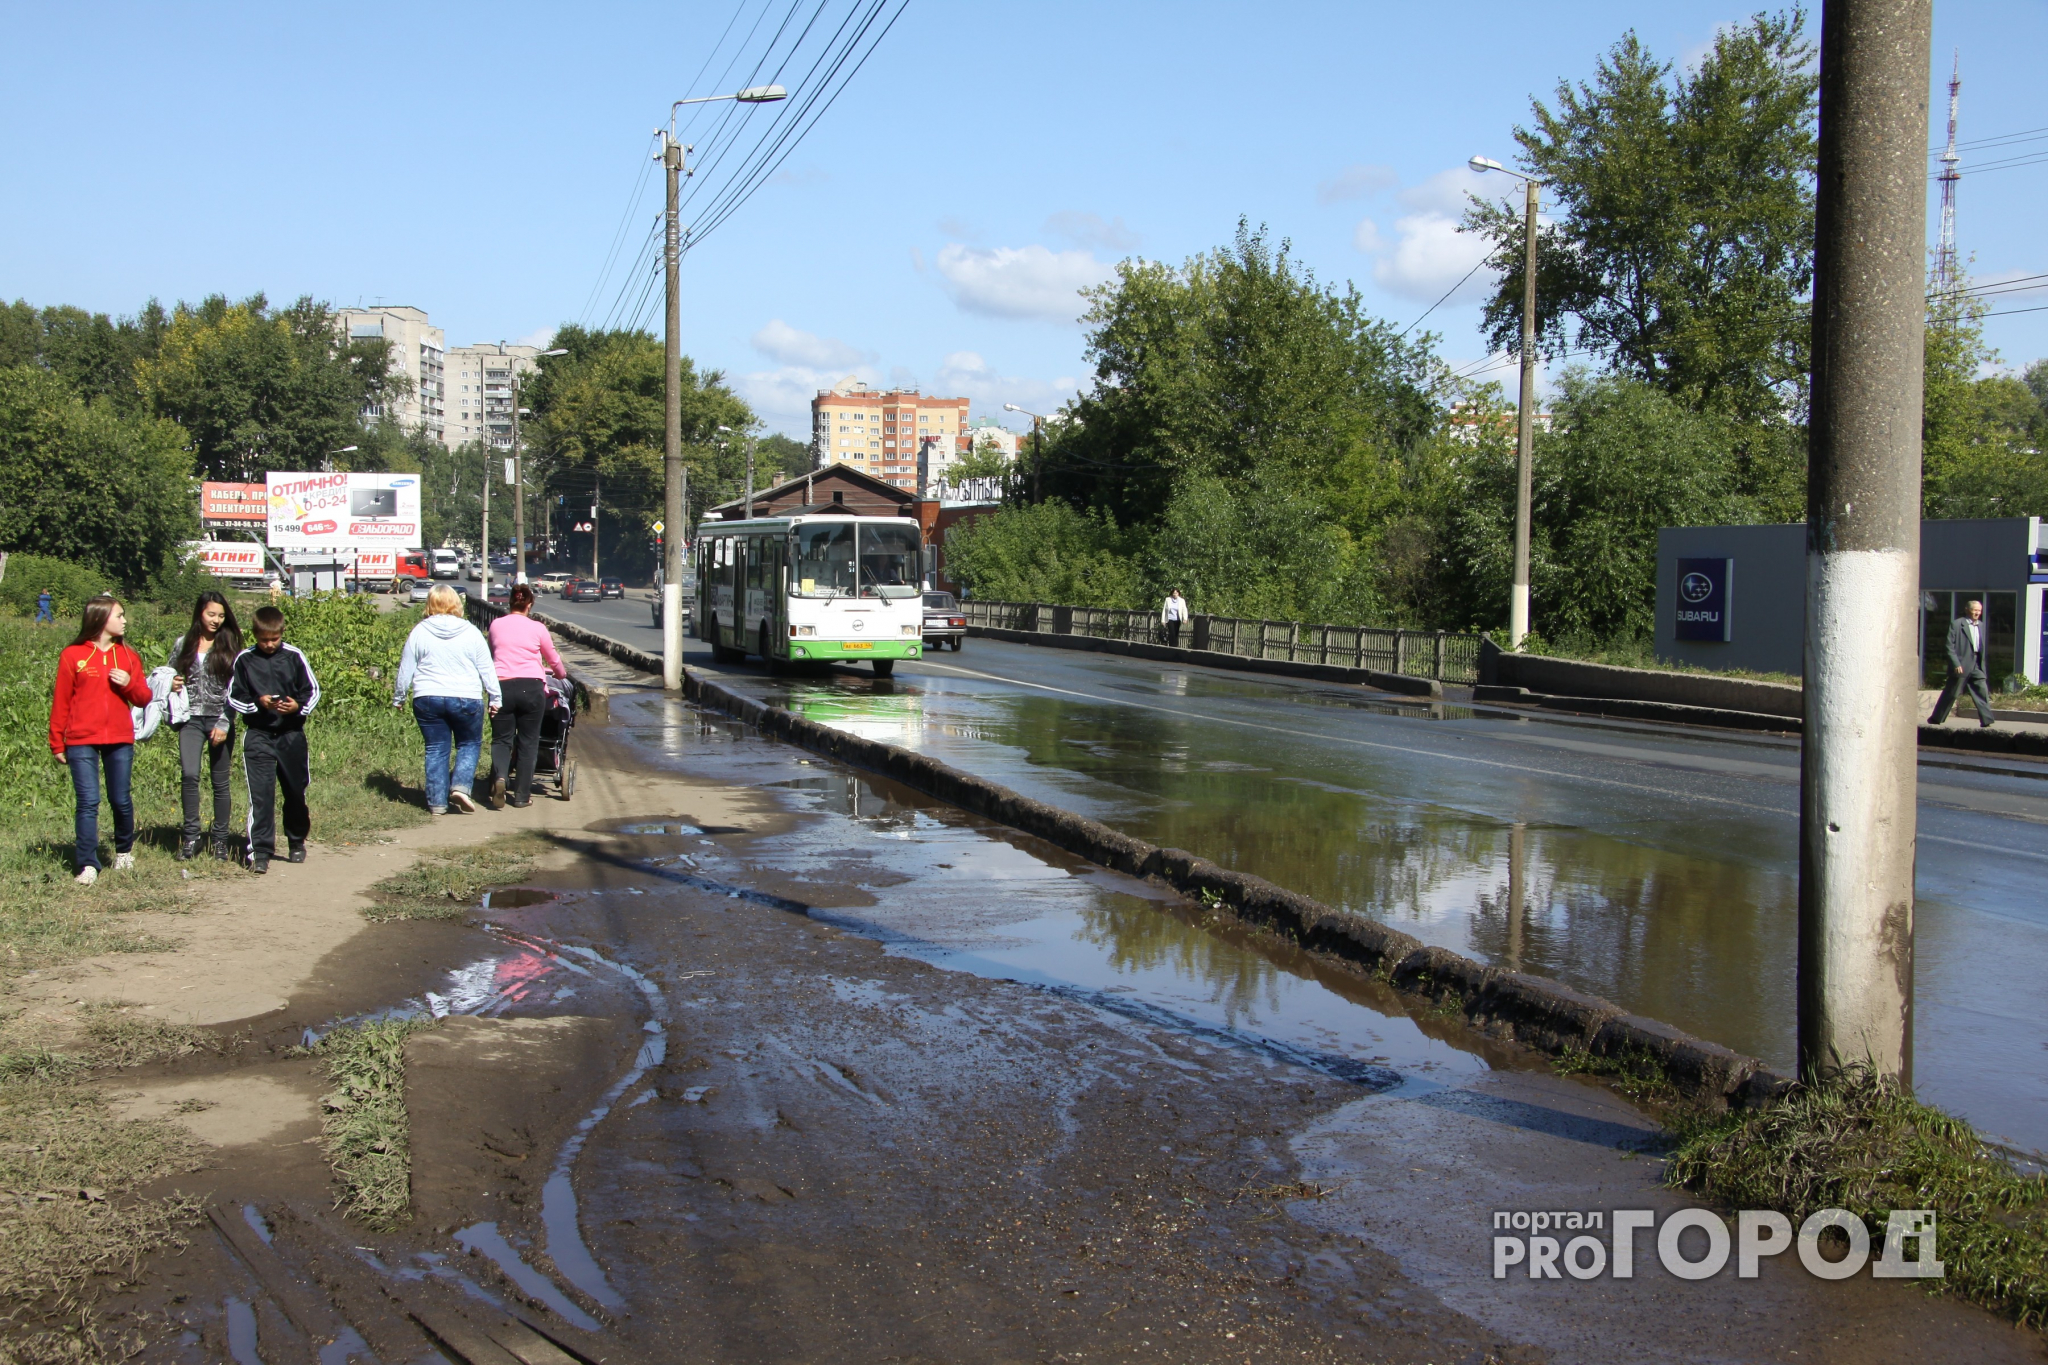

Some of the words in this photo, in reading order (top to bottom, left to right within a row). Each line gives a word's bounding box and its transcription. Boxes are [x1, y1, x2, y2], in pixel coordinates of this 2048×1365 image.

[272, 474, 347, 497] ОТЛИЧНО!
[310, 486, 347, 500] КРЕДИТ
[304, 495, 347, 511] 0-0-24
[1677, 610, 1718, 622] SUBARU
